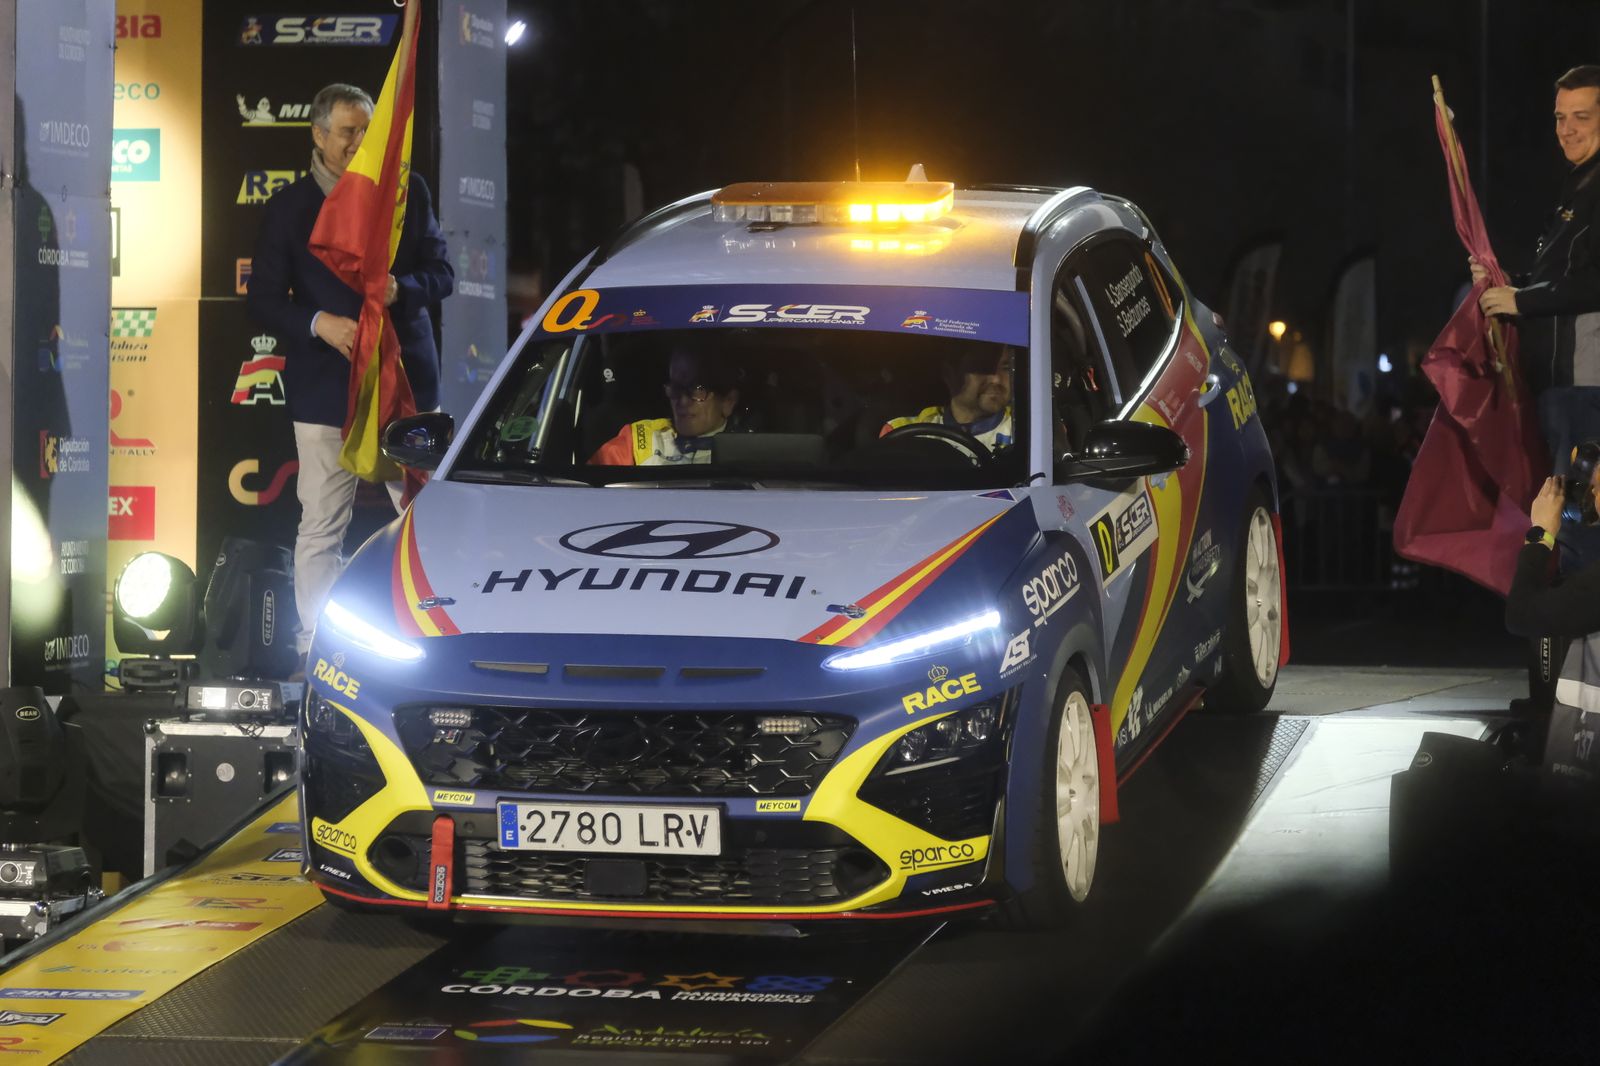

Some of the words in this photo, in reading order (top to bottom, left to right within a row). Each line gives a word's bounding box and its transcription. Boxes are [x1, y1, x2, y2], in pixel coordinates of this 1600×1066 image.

[51, 121, 89, 148] IMDECO
[112, 139, 151, 164] CO
[542, 289, 600, 333] Q
[111, 340, 149, 351] aluza
[1225, 370, 1257, 431] RAC
[60, 438, 90, 456] Diputación
[481, 567, 807, 600] HYUNDAI
[1022, 551, 1078, 626] sparco
[56, 634, 90, 661] IMDECO
[312, 658, 361, 700] RACE
[902, 672, 983, 716] RACE
[436, 790, 474, 804] MEYCOM
[758, 801, 799, 811] MEYCOM
[316, 824, 357, 855] sparco
[505, 829, 514, 841] E
[525, 809, 622, 846] 2780
[900, 843, 975, 871] sparco
[433, 866, 446, 902] sparco
[440, 983, 661, 1000] CÓRDOBA
